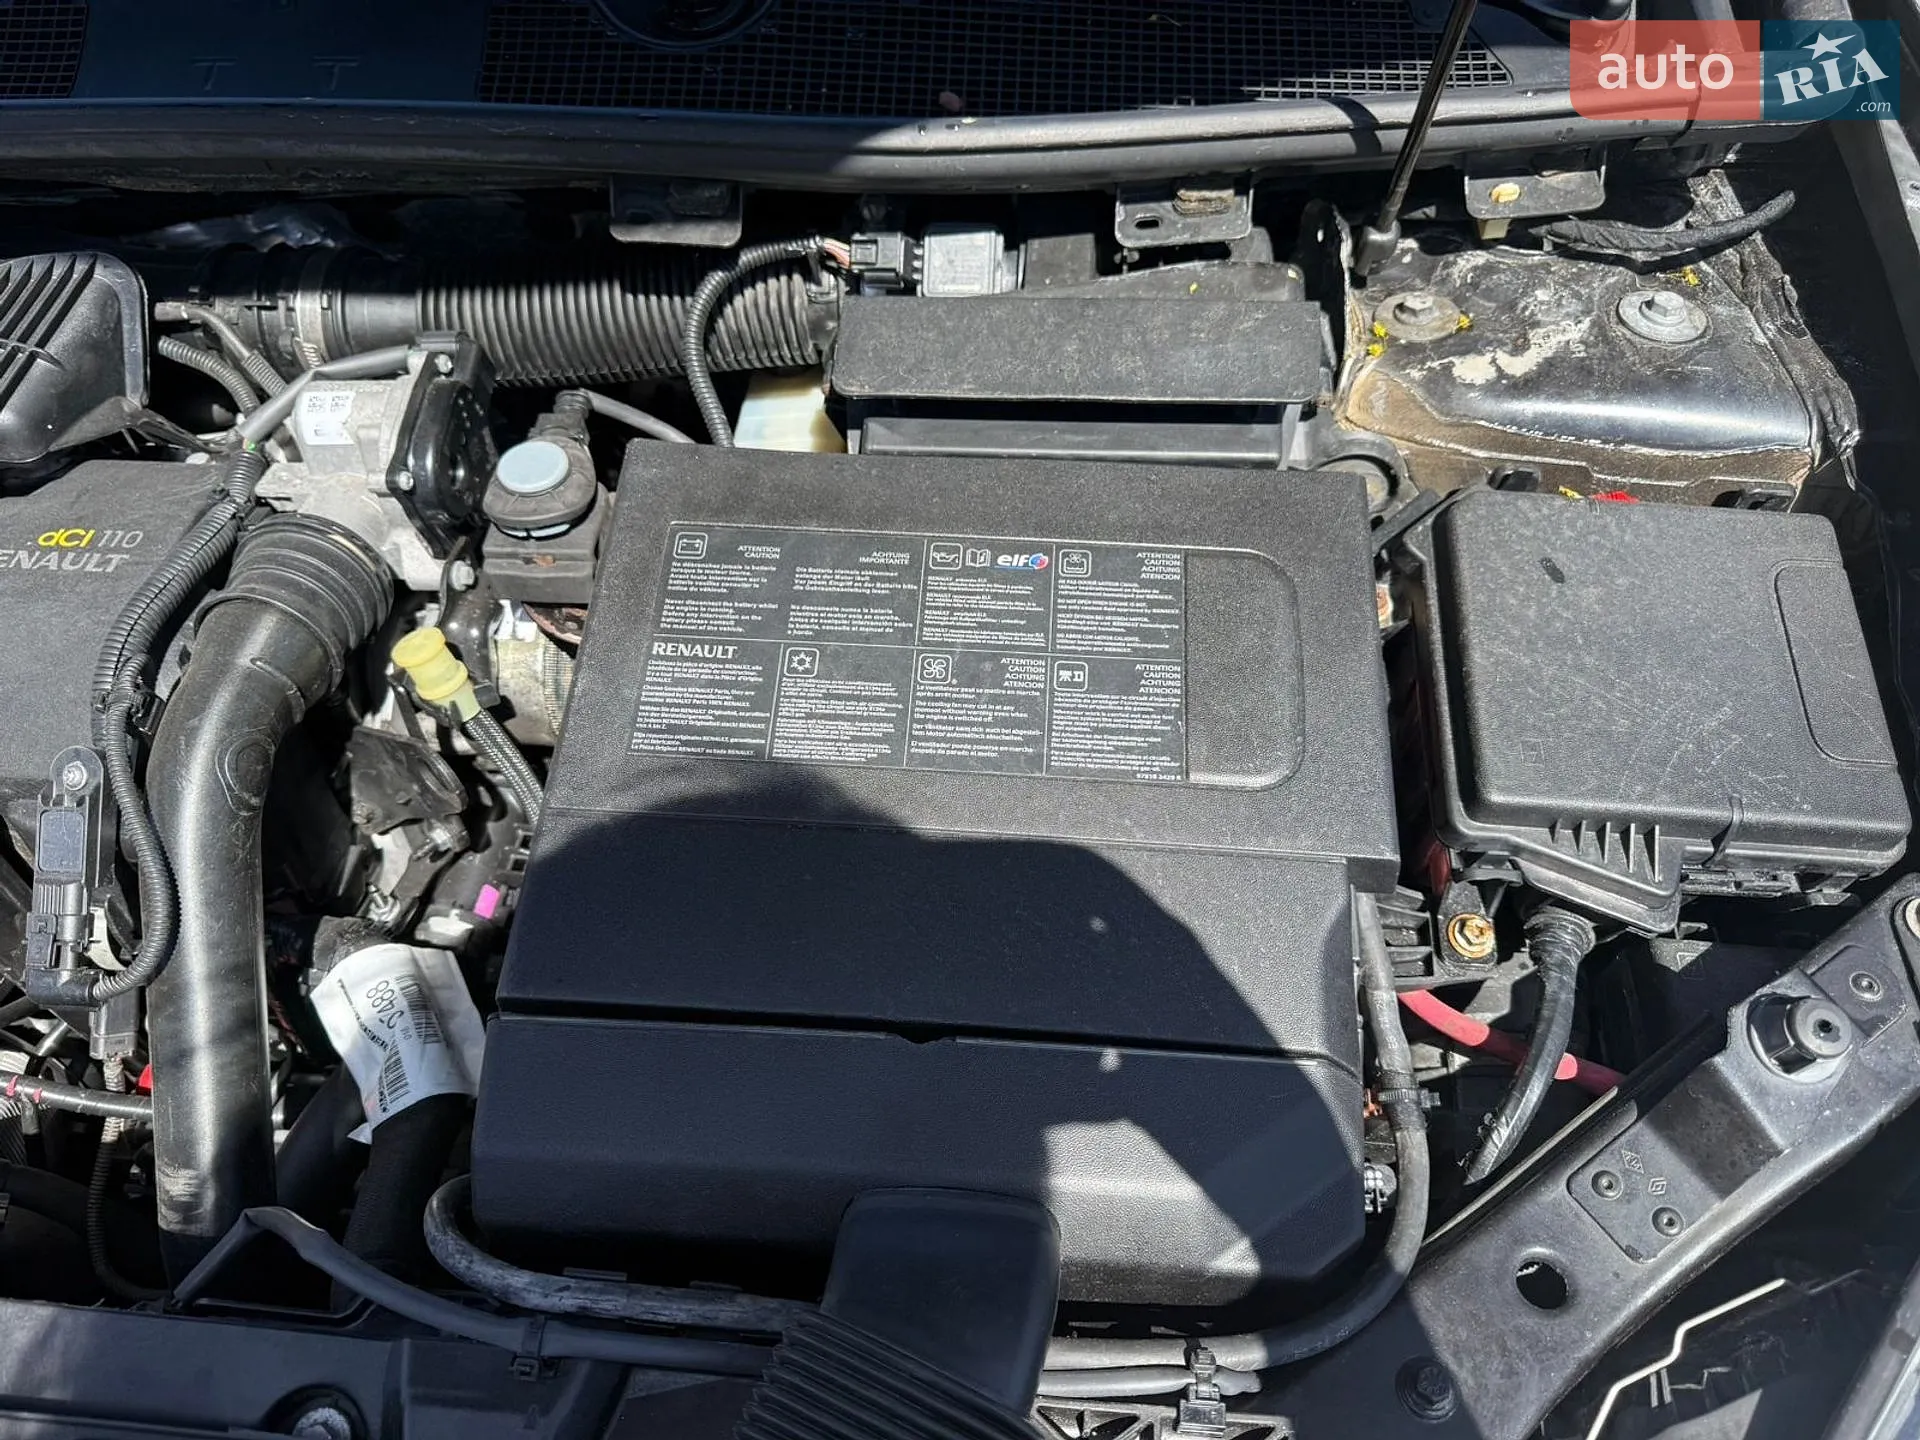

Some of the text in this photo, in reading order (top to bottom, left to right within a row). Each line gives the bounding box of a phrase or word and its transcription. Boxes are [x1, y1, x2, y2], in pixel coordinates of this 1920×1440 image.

[98, 529, 144, 548] 110
[0, 549, 130, 573] ENAULT
[859, 557, 909, 565] IMPORTANTE
[997, 554, 1031, 567] elf
[652, 642, 738, 659] RENAULT
[1140, 679, 1181, 687] ACHTUNG
